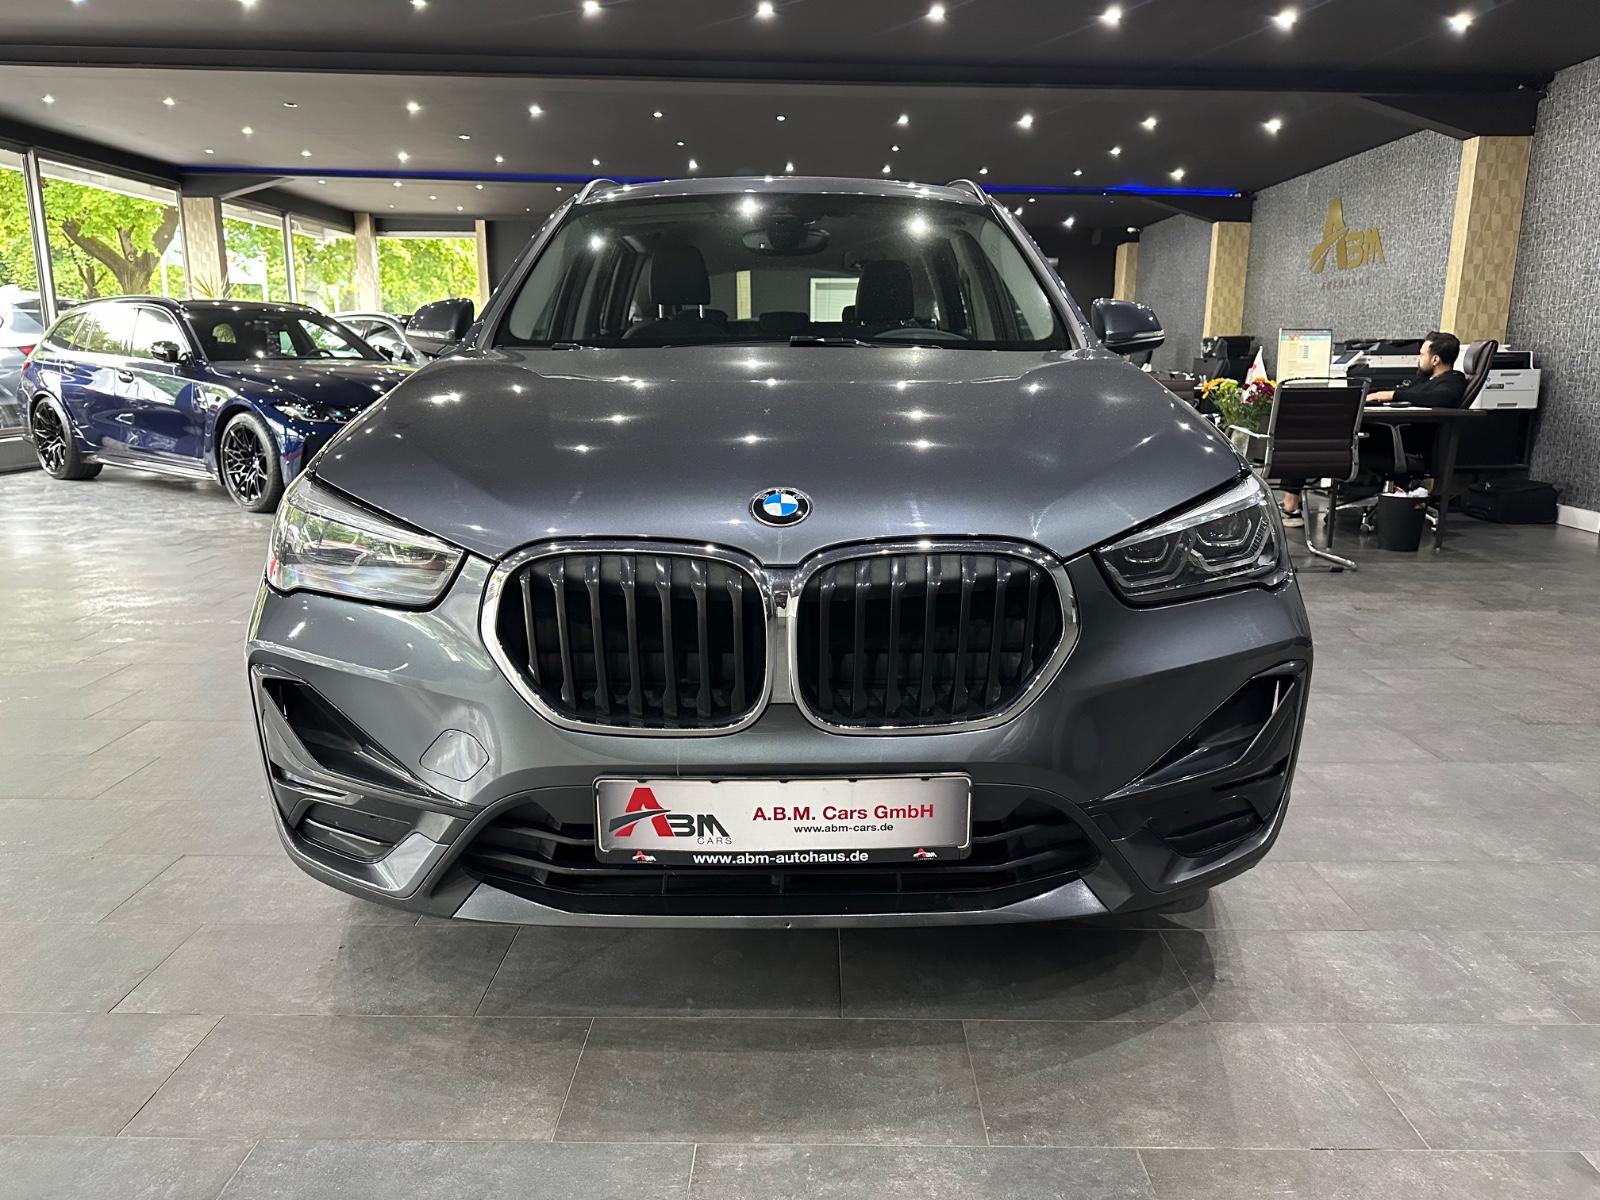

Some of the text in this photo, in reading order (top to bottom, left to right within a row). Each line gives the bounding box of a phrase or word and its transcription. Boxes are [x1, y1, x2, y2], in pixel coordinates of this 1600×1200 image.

[1310, 197, 1385, 274] ABM
[609, 787, 730, 837] ABM
[752, 804, 935, 821] A.B.M. Cars GmbH
[794, 823, 894, 833] www.abm-cars.de
[697, 837, 733, 845] CARS
[692, 851, 869, 864] www.abm-autohaus.de
